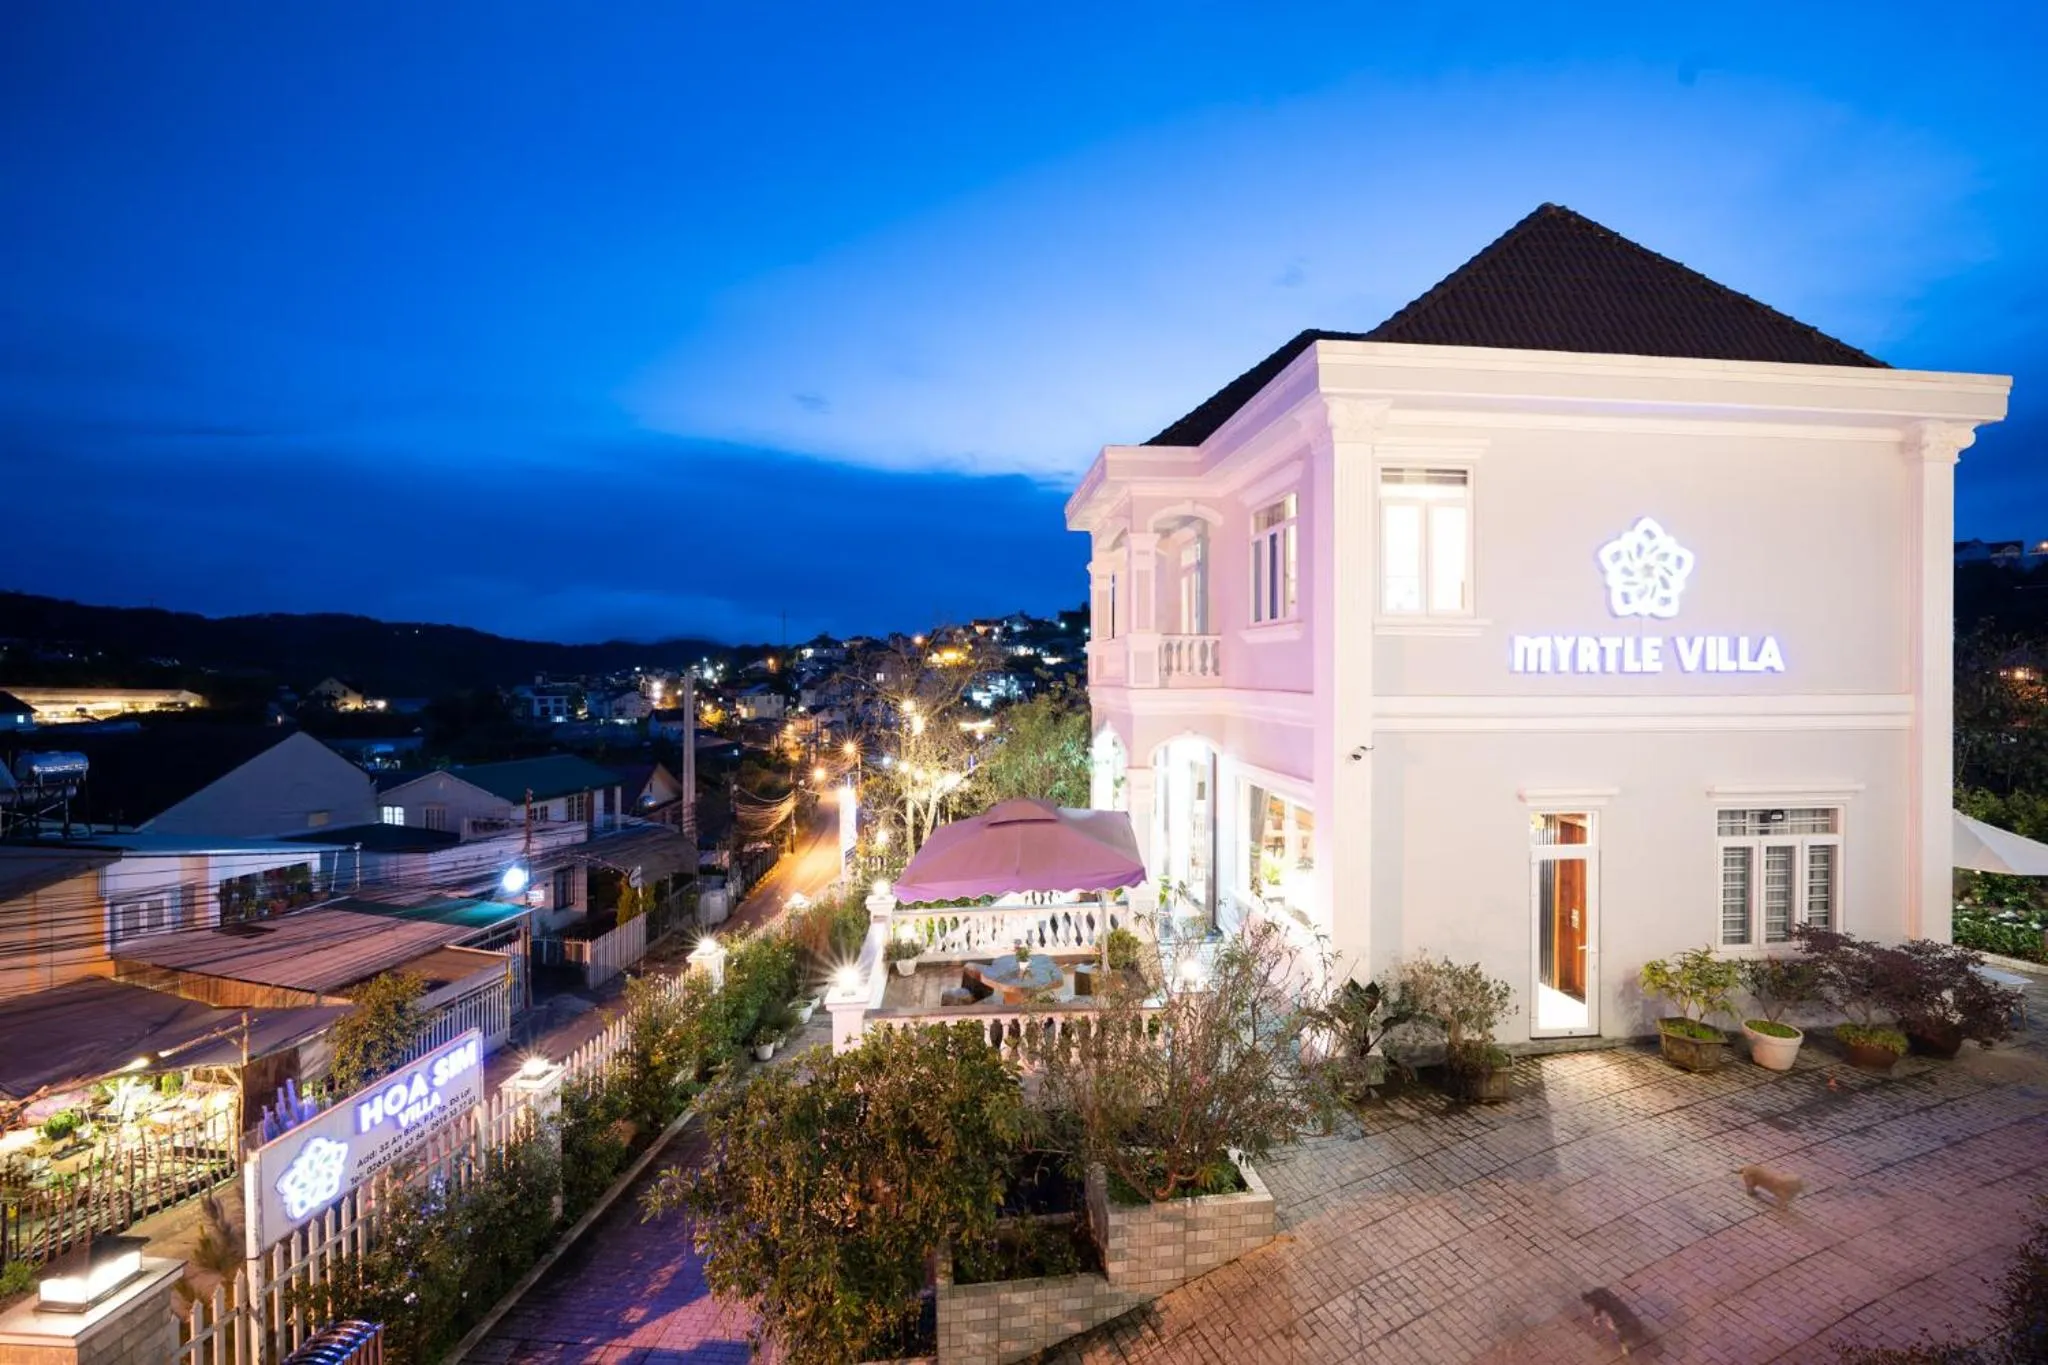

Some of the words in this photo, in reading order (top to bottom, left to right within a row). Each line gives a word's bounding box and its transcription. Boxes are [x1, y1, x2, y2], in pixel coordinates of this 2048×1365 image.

[1511, 634, 1663, 673] MYRTLE
[1674, 635, 1786, 673] VILLA
[357, 1071, 429, 1133] HOA
[431, 1039, 478, 1088] SIM
[397, 1091, 442, 1128] VILLA
